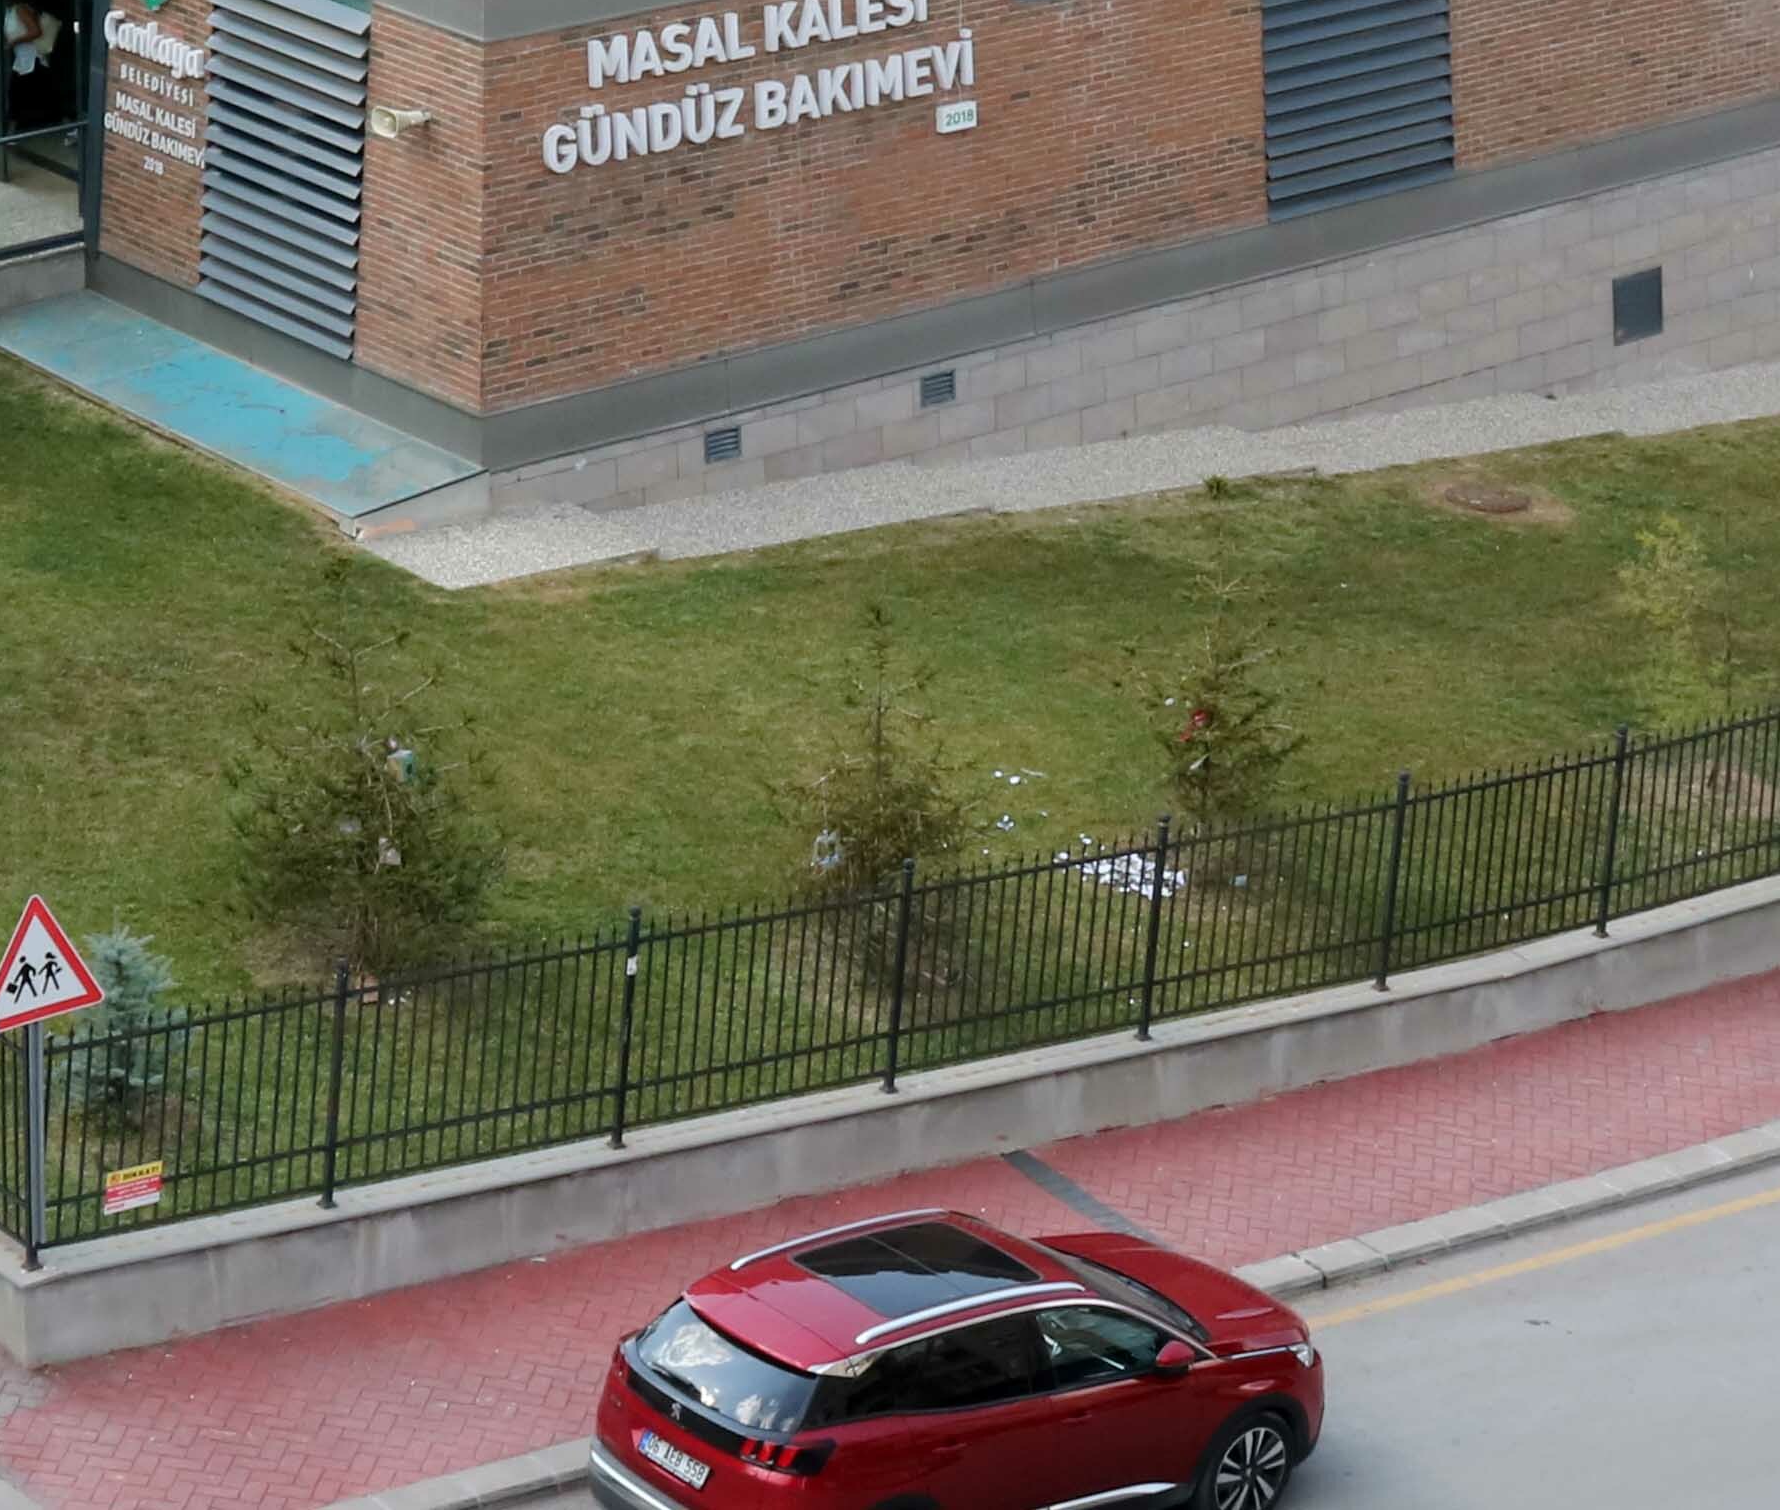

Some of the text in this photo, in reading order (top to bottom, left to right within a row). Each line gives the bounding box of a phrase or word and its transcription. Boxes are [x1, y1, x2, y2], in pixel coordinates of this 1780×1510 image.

[104, 10, 205, 79] Çankaya
[587, 11, 756, 88] MASAL
[120, 63, 194, 107] BELEDİYESİ
[542, 27, 976, 175] GÜNDÜZ BAKIMEVİ
[104, 112, 151, 146] GÜNDÜZ
[115, 91, 197, 139] MASAL KALESİ
[945, 108, 975, 128] 2018
